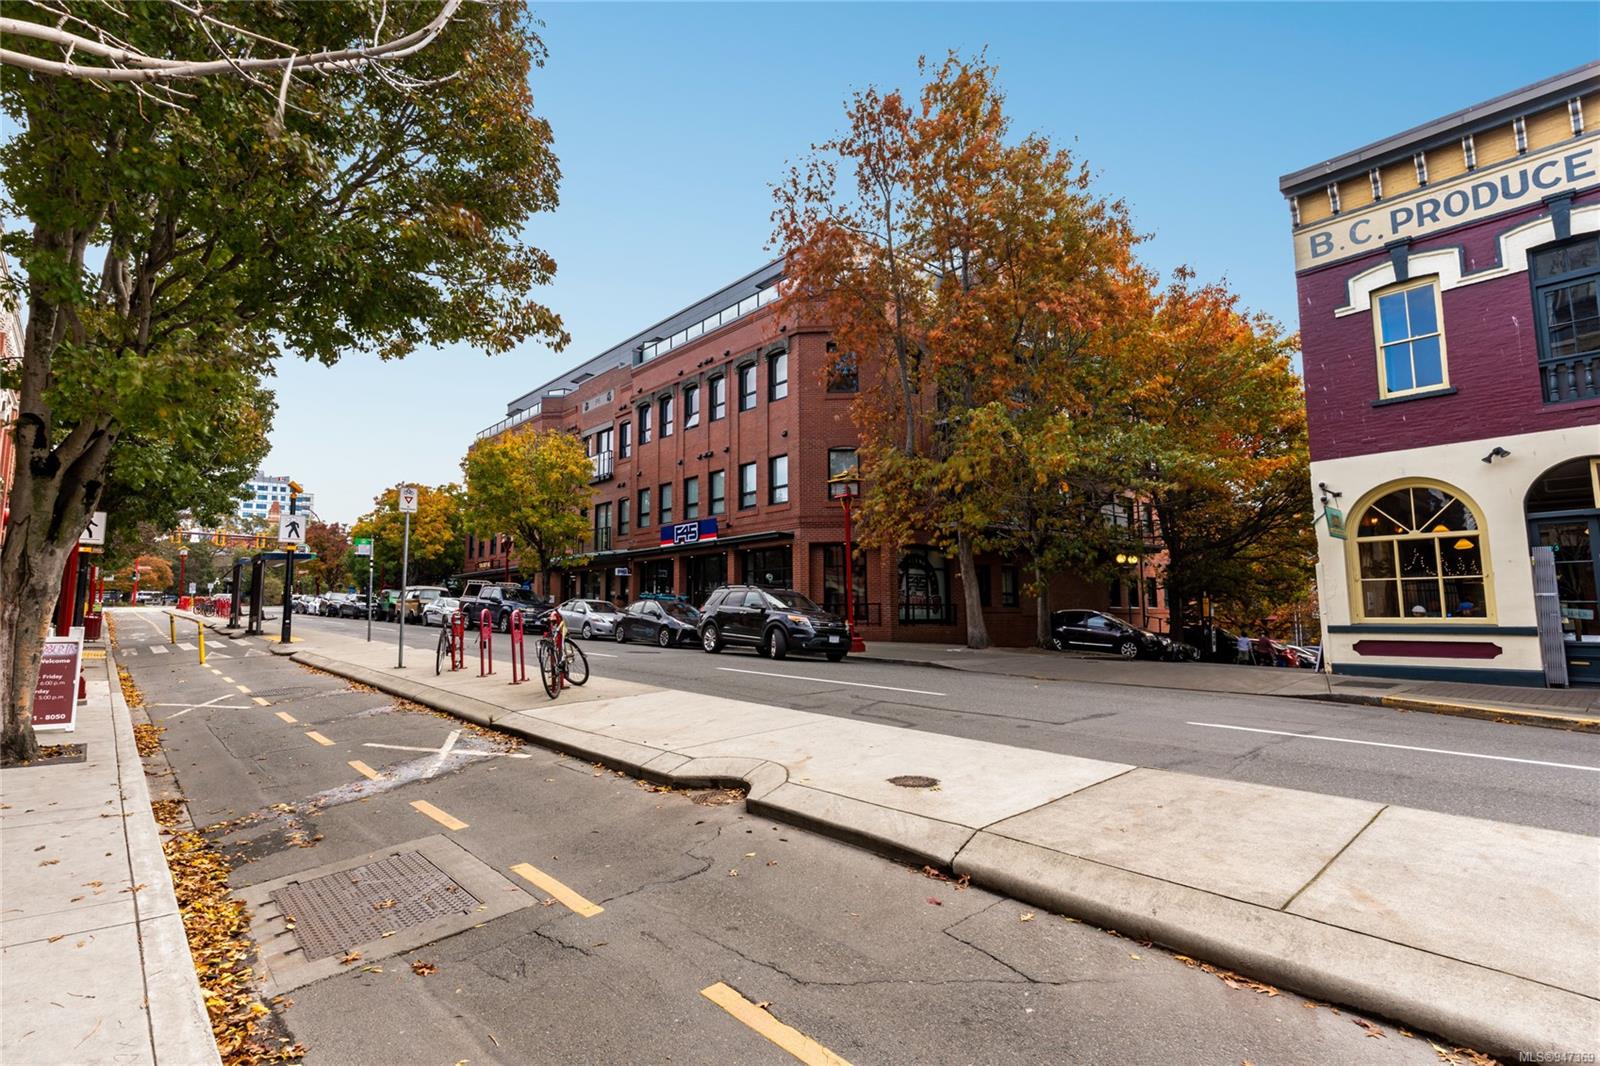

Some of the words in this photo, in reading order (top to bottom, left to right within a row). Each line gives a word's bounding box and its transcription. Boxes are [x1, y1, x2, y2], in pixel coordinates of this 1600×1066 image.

[1390, 149, 1597, 235] PRODUCE
[674, 522, 698, 543] F45
[45, 713, 66, 721] 8050
